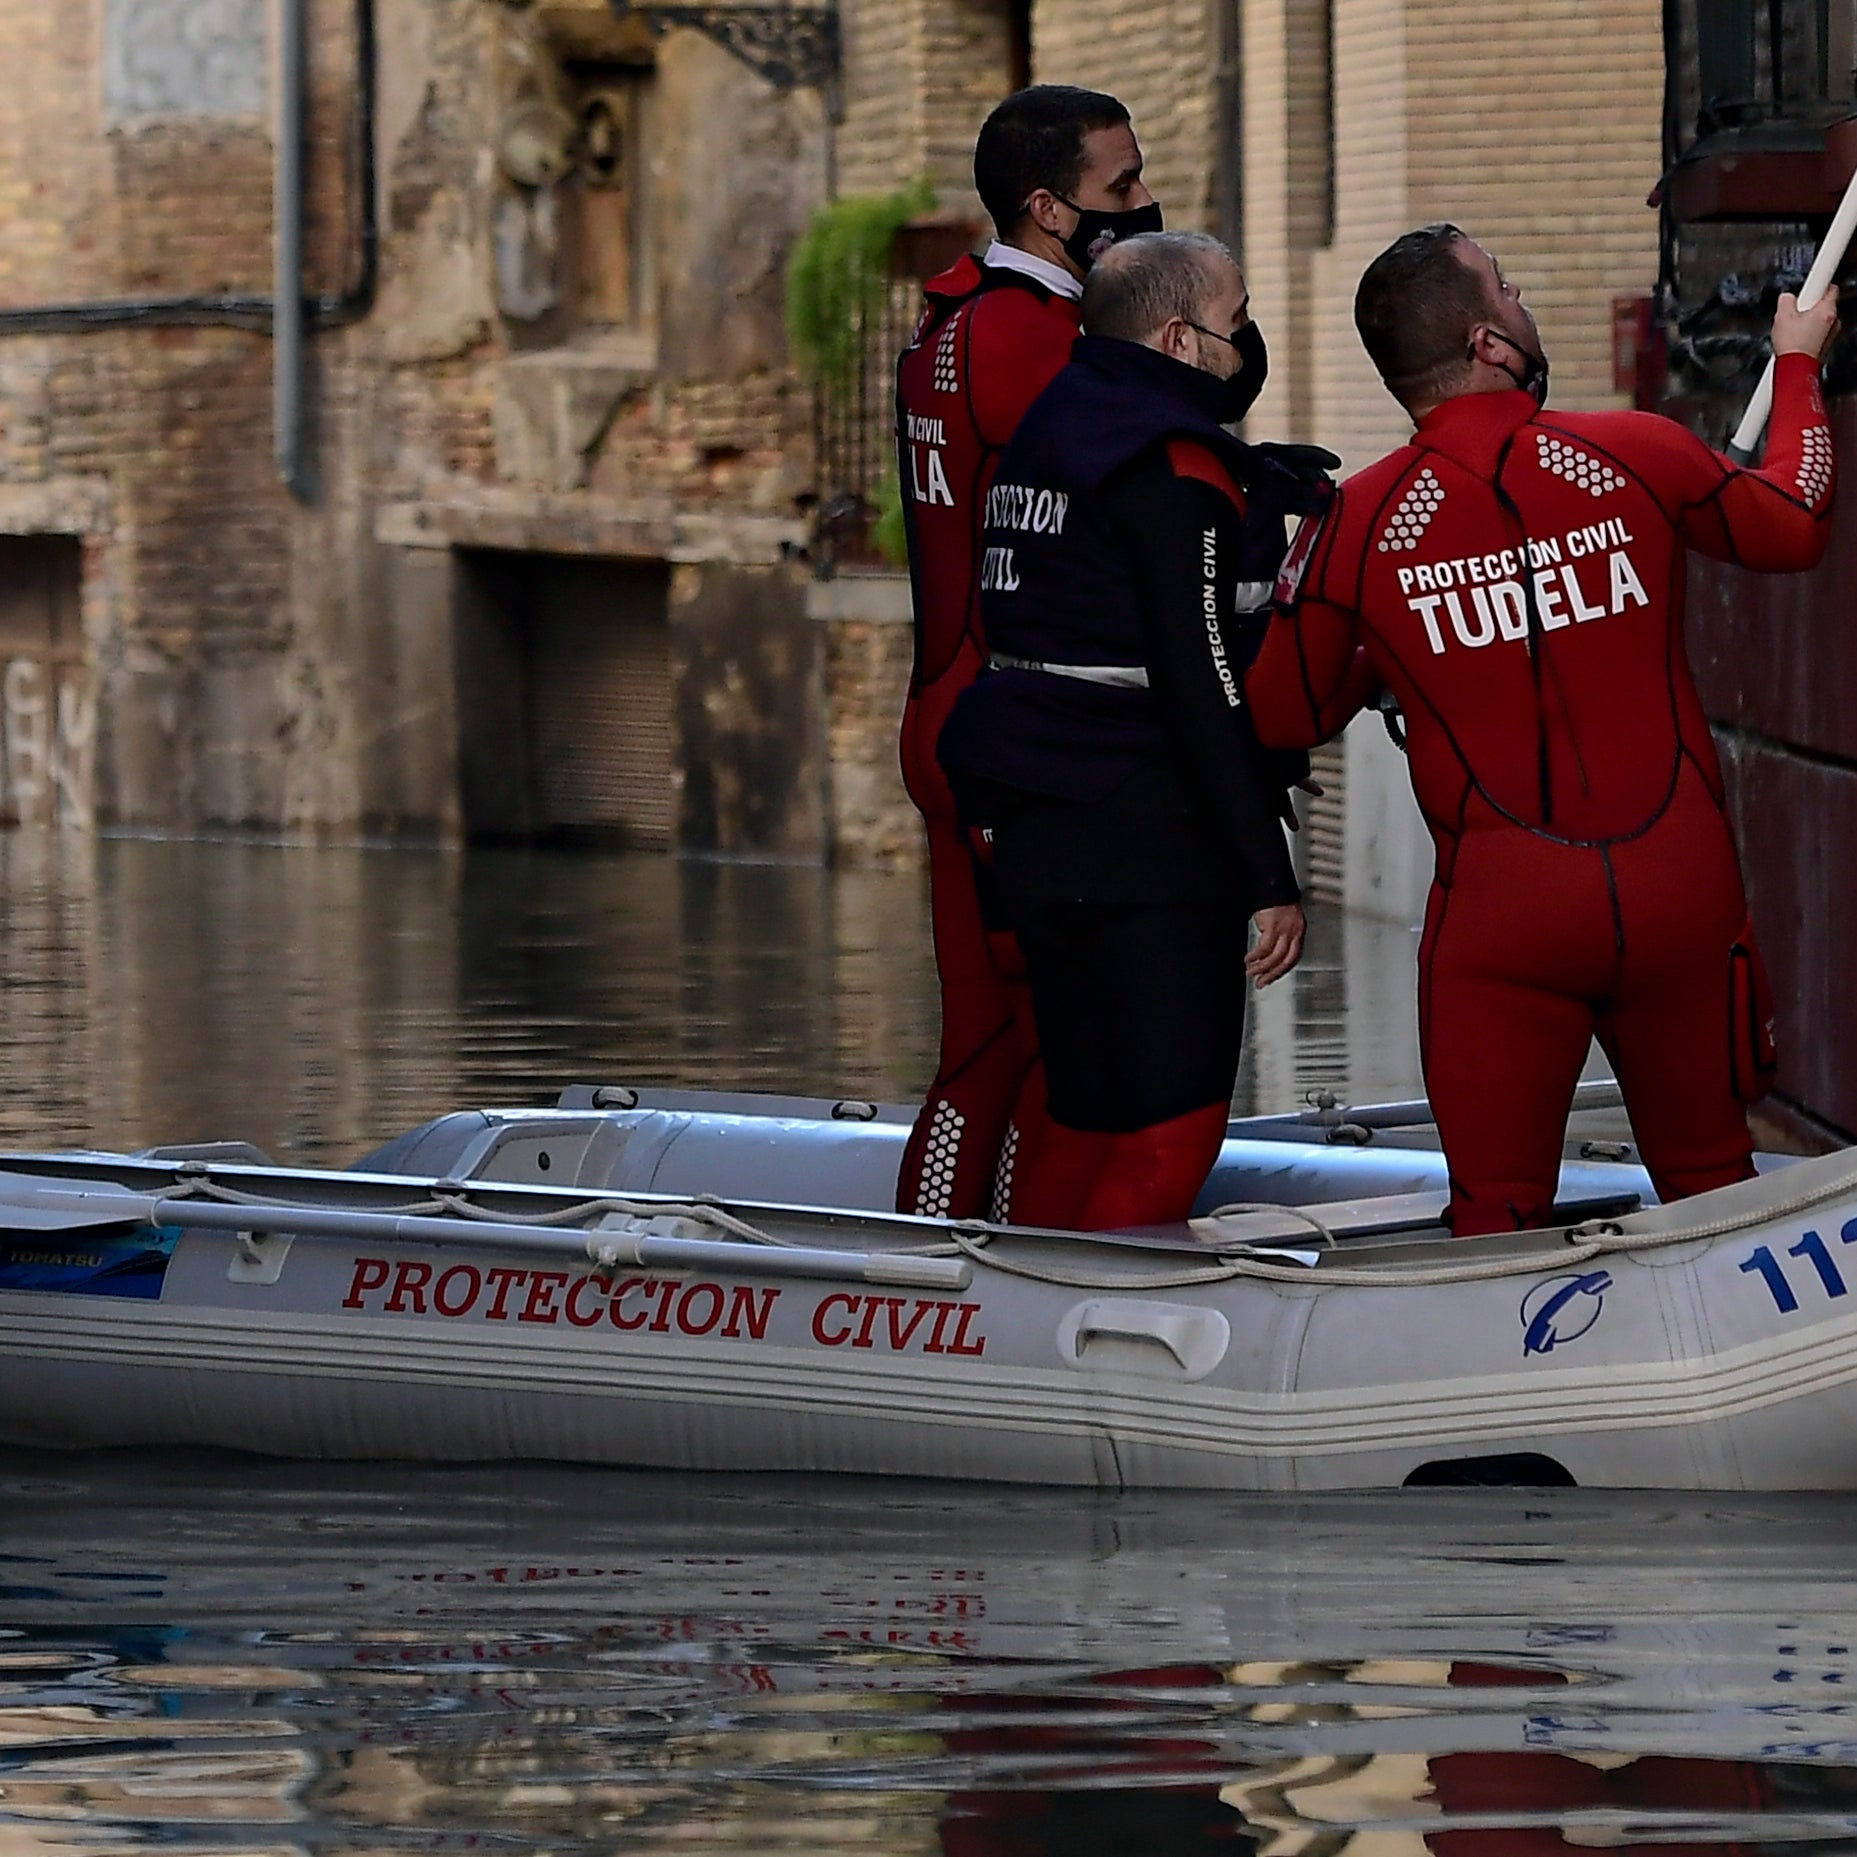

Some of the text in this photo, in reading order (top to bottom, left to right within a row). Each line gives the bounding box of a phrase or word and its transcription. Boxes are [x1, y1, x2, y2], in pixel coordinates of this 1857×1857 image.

[1202, 526, 1217, 580] CIVIL
[1565, 516, 1634, 558] CIVIL
[1406, 549, 1650, 655] TUDELA
[341, 1257, 987, 1357] PROTECCION CIVIL
